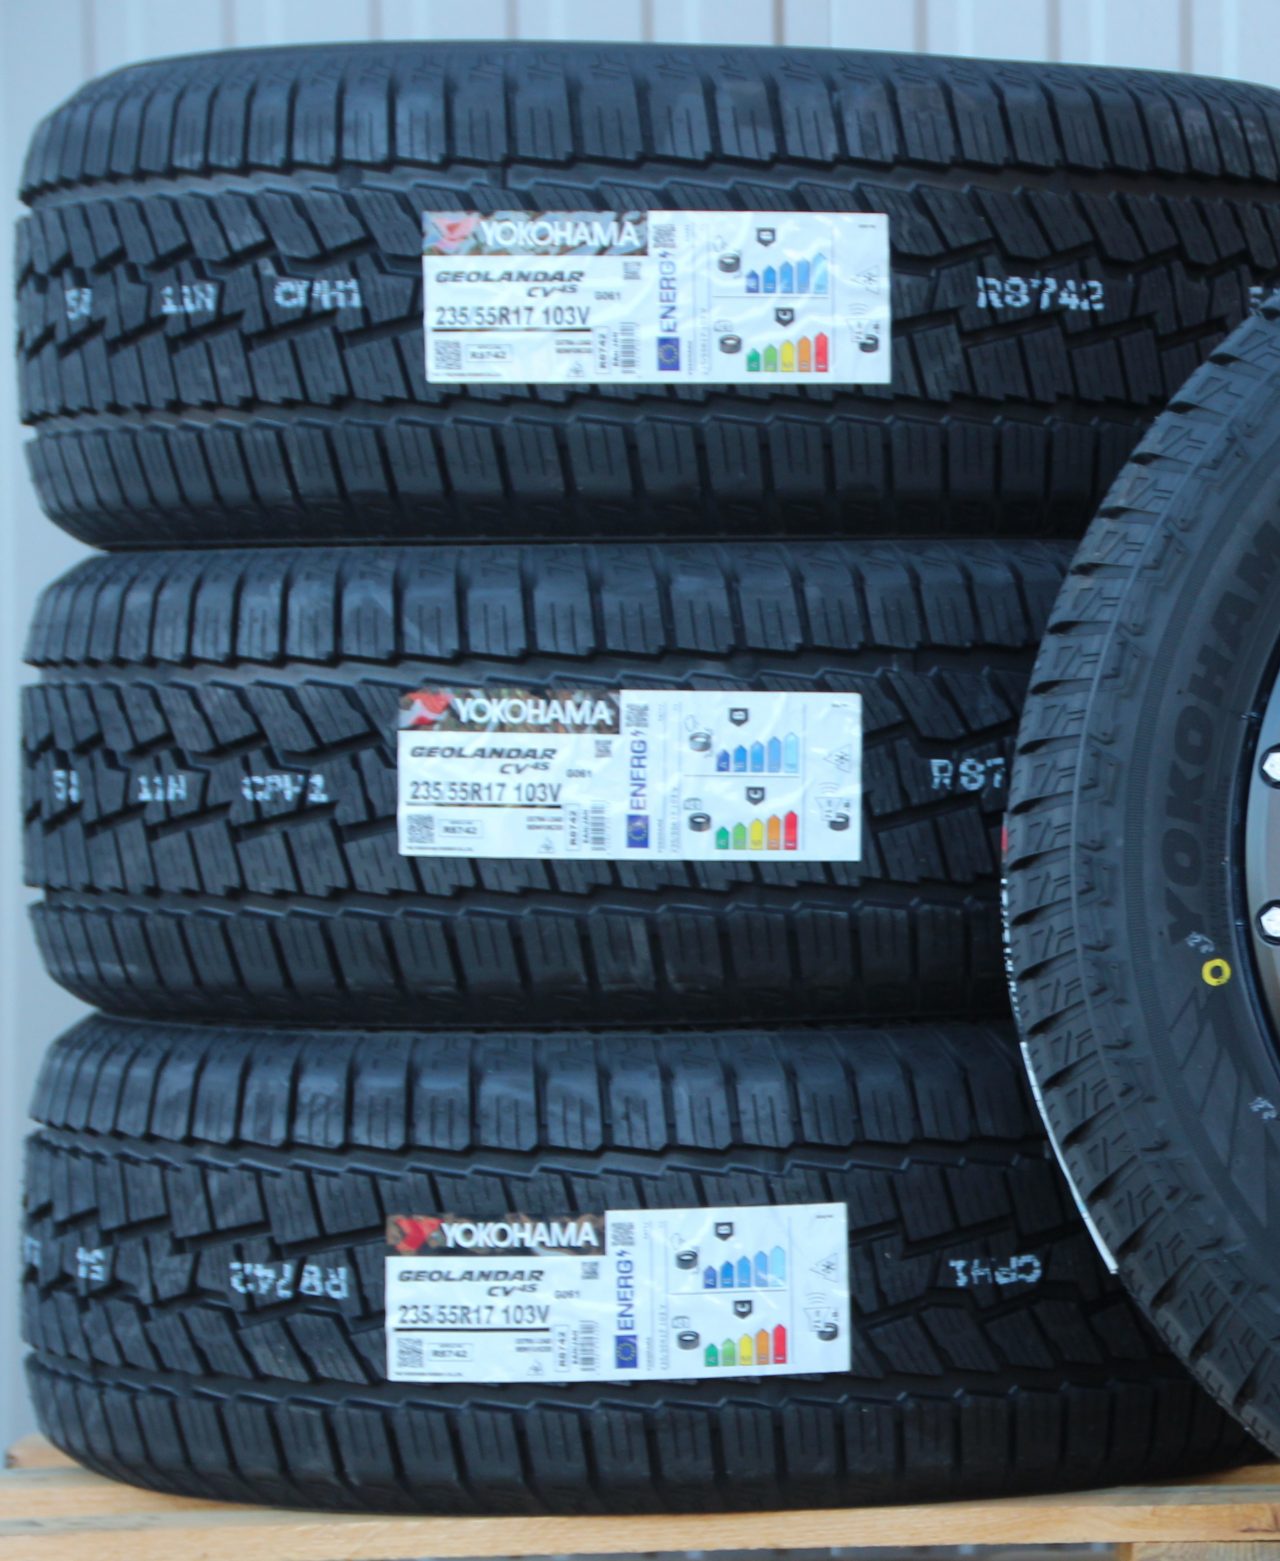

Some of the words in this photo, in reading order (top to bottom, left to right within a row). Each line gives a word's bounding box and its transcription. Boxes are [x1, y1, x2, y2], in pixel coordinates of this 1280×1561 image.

[481, 220, 641, 247] YOKOHAMA
[435, 270, 584, 283] GEOLANDAR
[658, 260, 678, 332] ENERG
[976, 275, 1105, 310] R8742
[543, 306, 590, 326] 103V
[456, 698, 613, 725] YOKOHAMA
[410, 745, 557, 760] GEOLANDAR
[630, 739, 647, 810] ENERG
[514, 783, 562, 802] 103V
[441, 1222, 599, 1247] YOKOHAMA
[230, 1261, 348, 1300] R8742
[398, 1270, 544, 1283] GEOLANDAR
[617, 1260, 635, 1331] ENERG
[503, 1305, 550, 1325] 103V
